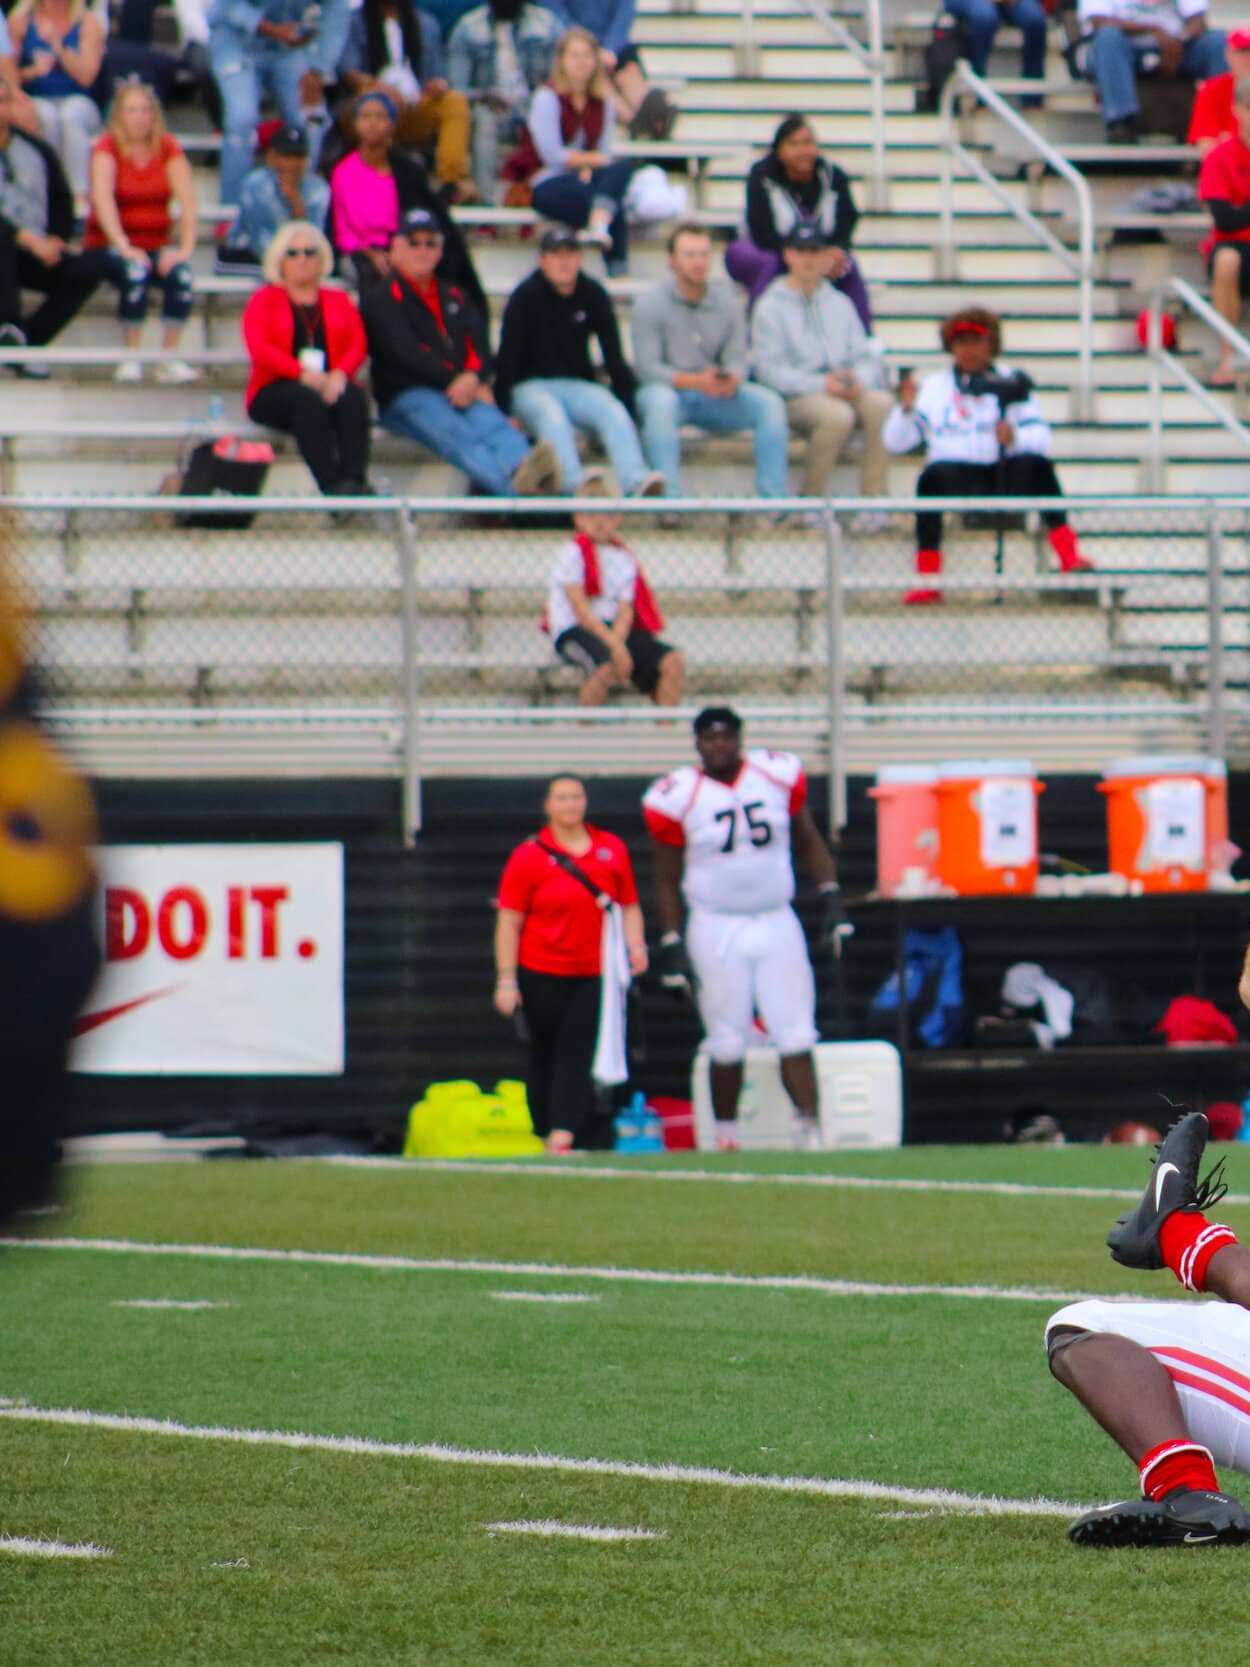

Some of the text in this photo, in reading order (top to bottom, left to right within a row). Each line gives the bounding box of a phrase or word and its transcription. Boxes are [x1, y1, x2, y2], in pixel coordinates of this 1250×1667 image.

[714, 801, 772, 854] 75
[105, 883, 316, 962] DO IT.
